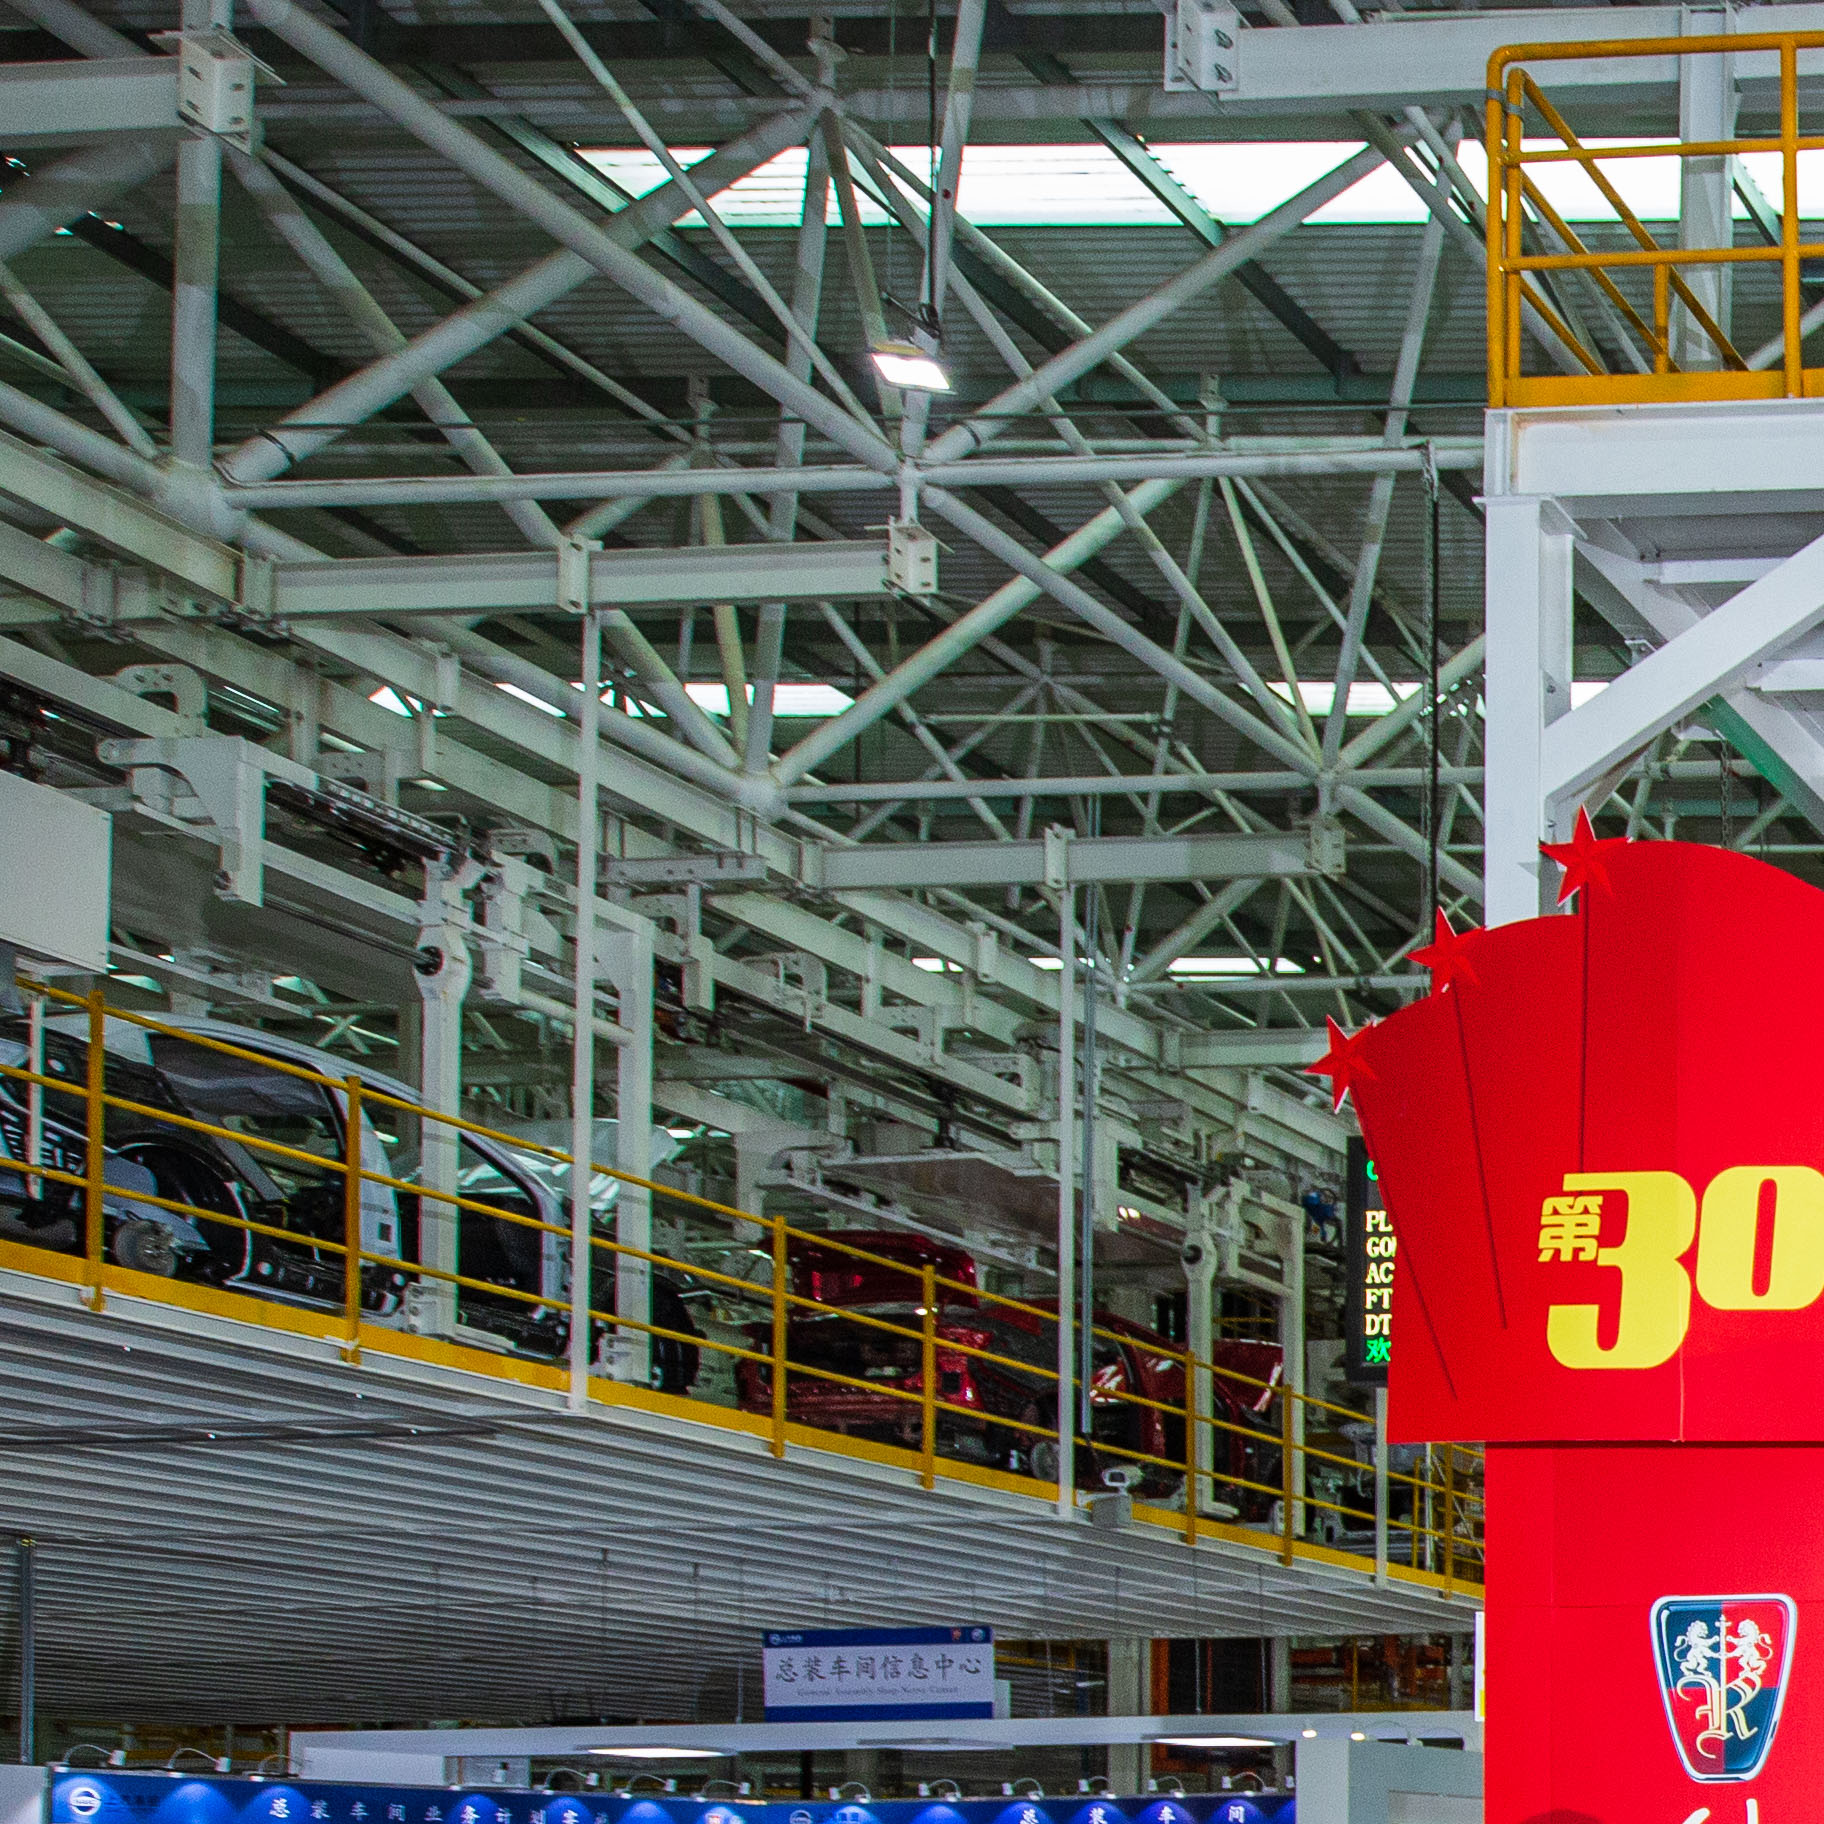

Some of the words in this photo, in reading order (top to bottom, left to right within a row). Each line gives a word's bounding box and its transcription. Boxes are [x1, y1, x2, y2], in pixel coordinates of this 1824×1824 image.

[776, 1653, 981, 1682] 总装车间信息中心
